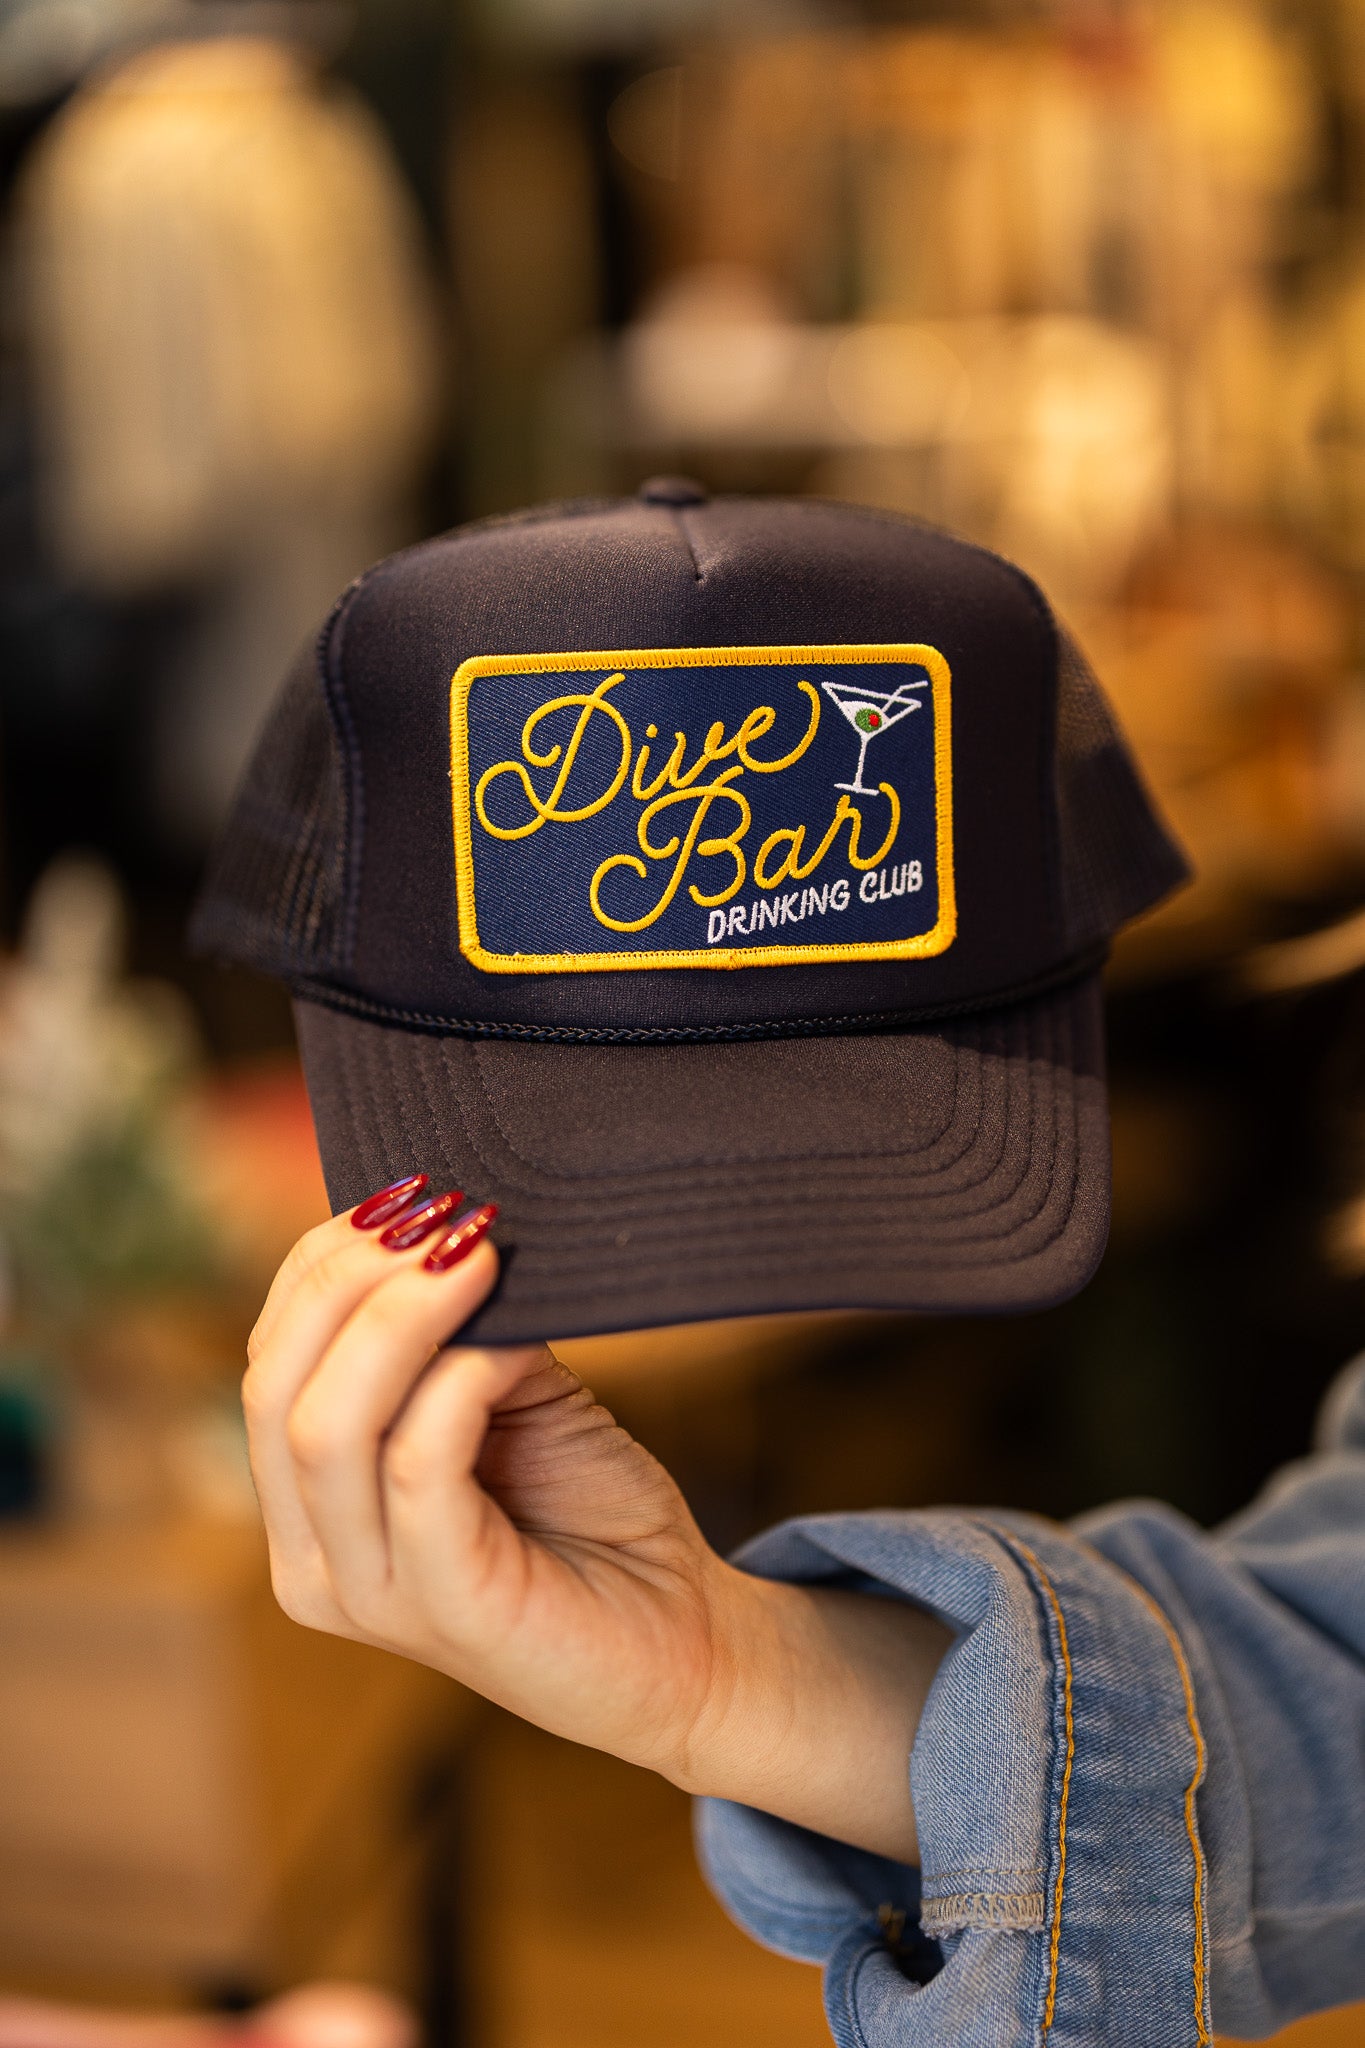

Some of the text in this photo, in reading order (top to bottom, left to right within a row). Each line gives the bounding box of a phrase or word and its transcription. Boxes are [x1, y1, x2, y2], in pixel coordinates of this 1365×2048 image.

[475, 672, 821, 841] Dive
[590, 765, 901, 932] Bar
[707, 860, 925, 944] DRINKING CLUB
